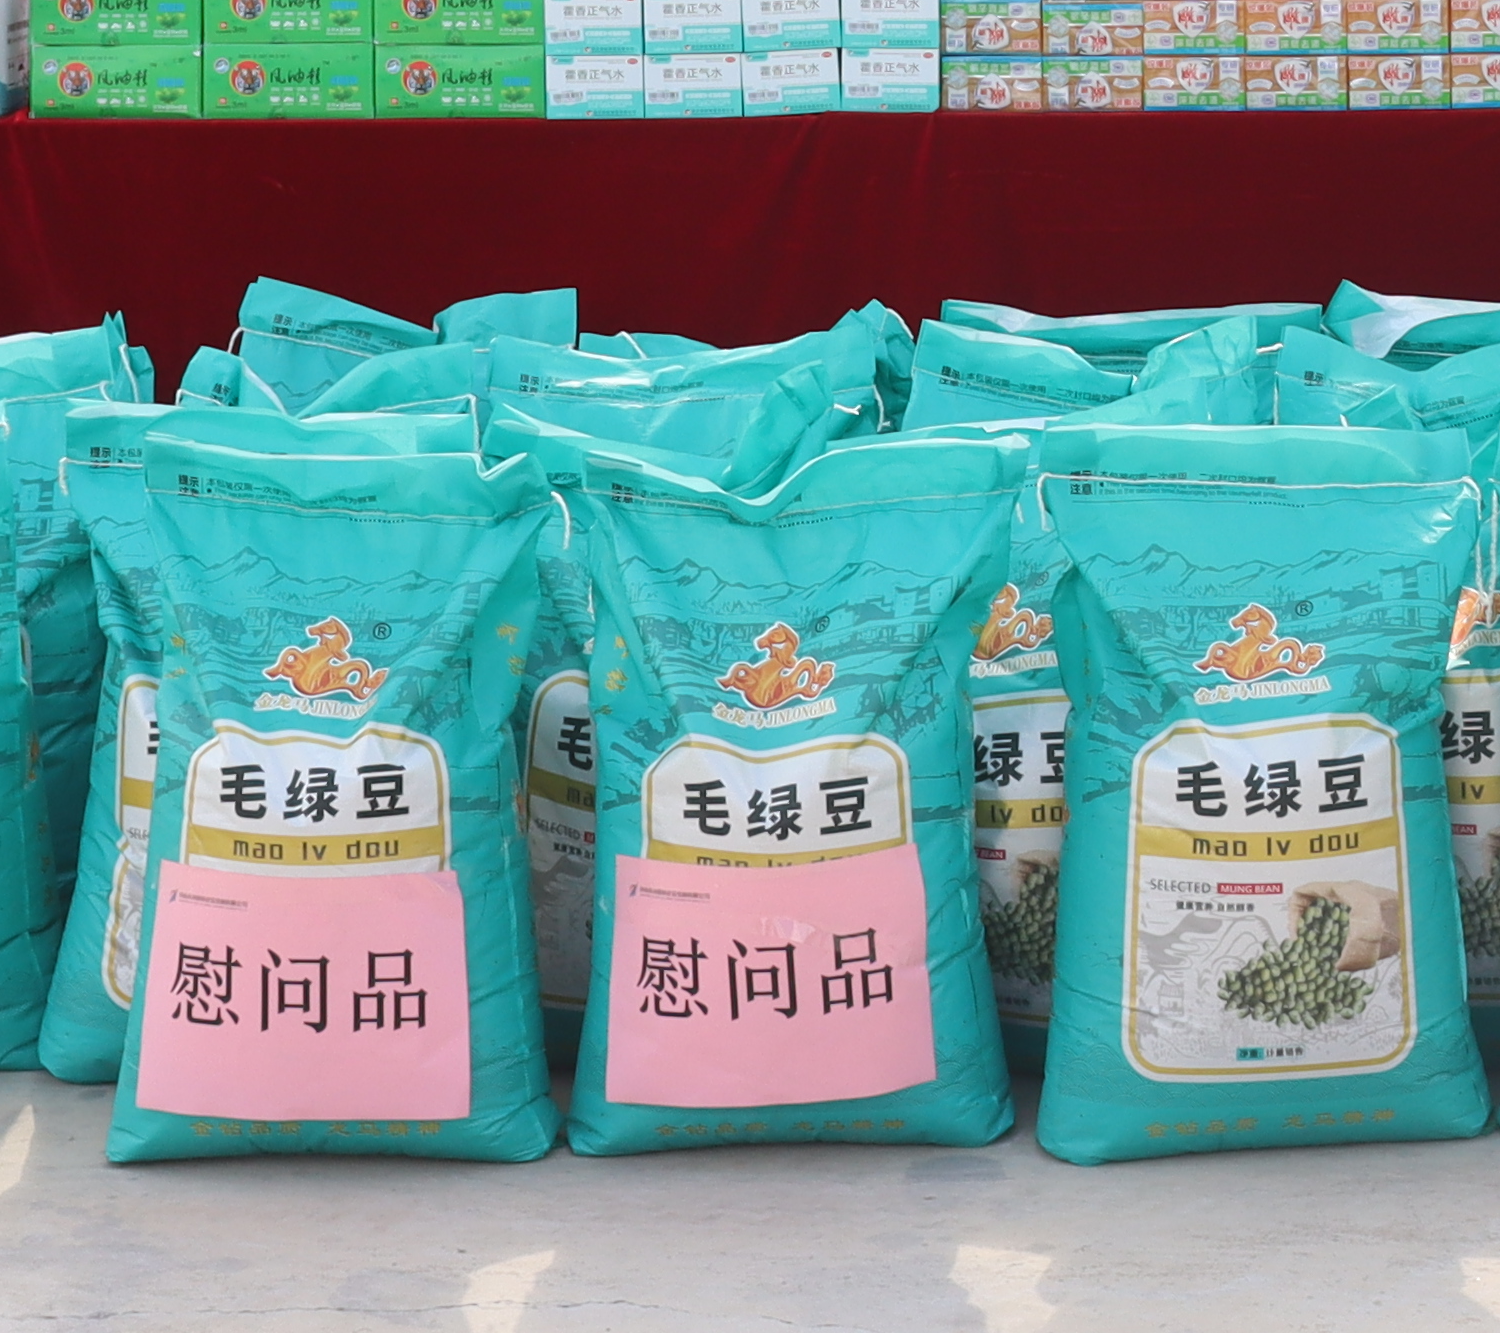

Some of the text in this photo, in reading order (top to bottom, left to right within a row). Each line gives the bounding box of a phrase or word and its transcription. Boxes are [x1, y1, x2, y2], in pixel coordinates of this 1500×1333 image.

[1070, 484, 1093, 495] 注意
[1251, 676, 1331, 697] JINLONGMA
[766, 698, 836, 728] JINLONGMA
[220, 763, 410, 822] 毛绿豆
[1175, 755, 1367, 818] 毛绿豆
[1463, 782, 1483, 799] lv
[683, 776, 872, 841] 毛绿豆
[990, 804, 1012, 823] lv
[234, 839, 400, 861] mao lv dou
[1192, 831, 1359, 857] mao lv dou
[1150, 878, 1211, 894] SELECTED
[637, 927, 895, 1021] 慰问品
[169, 942, 427, 1034] 慰问品
